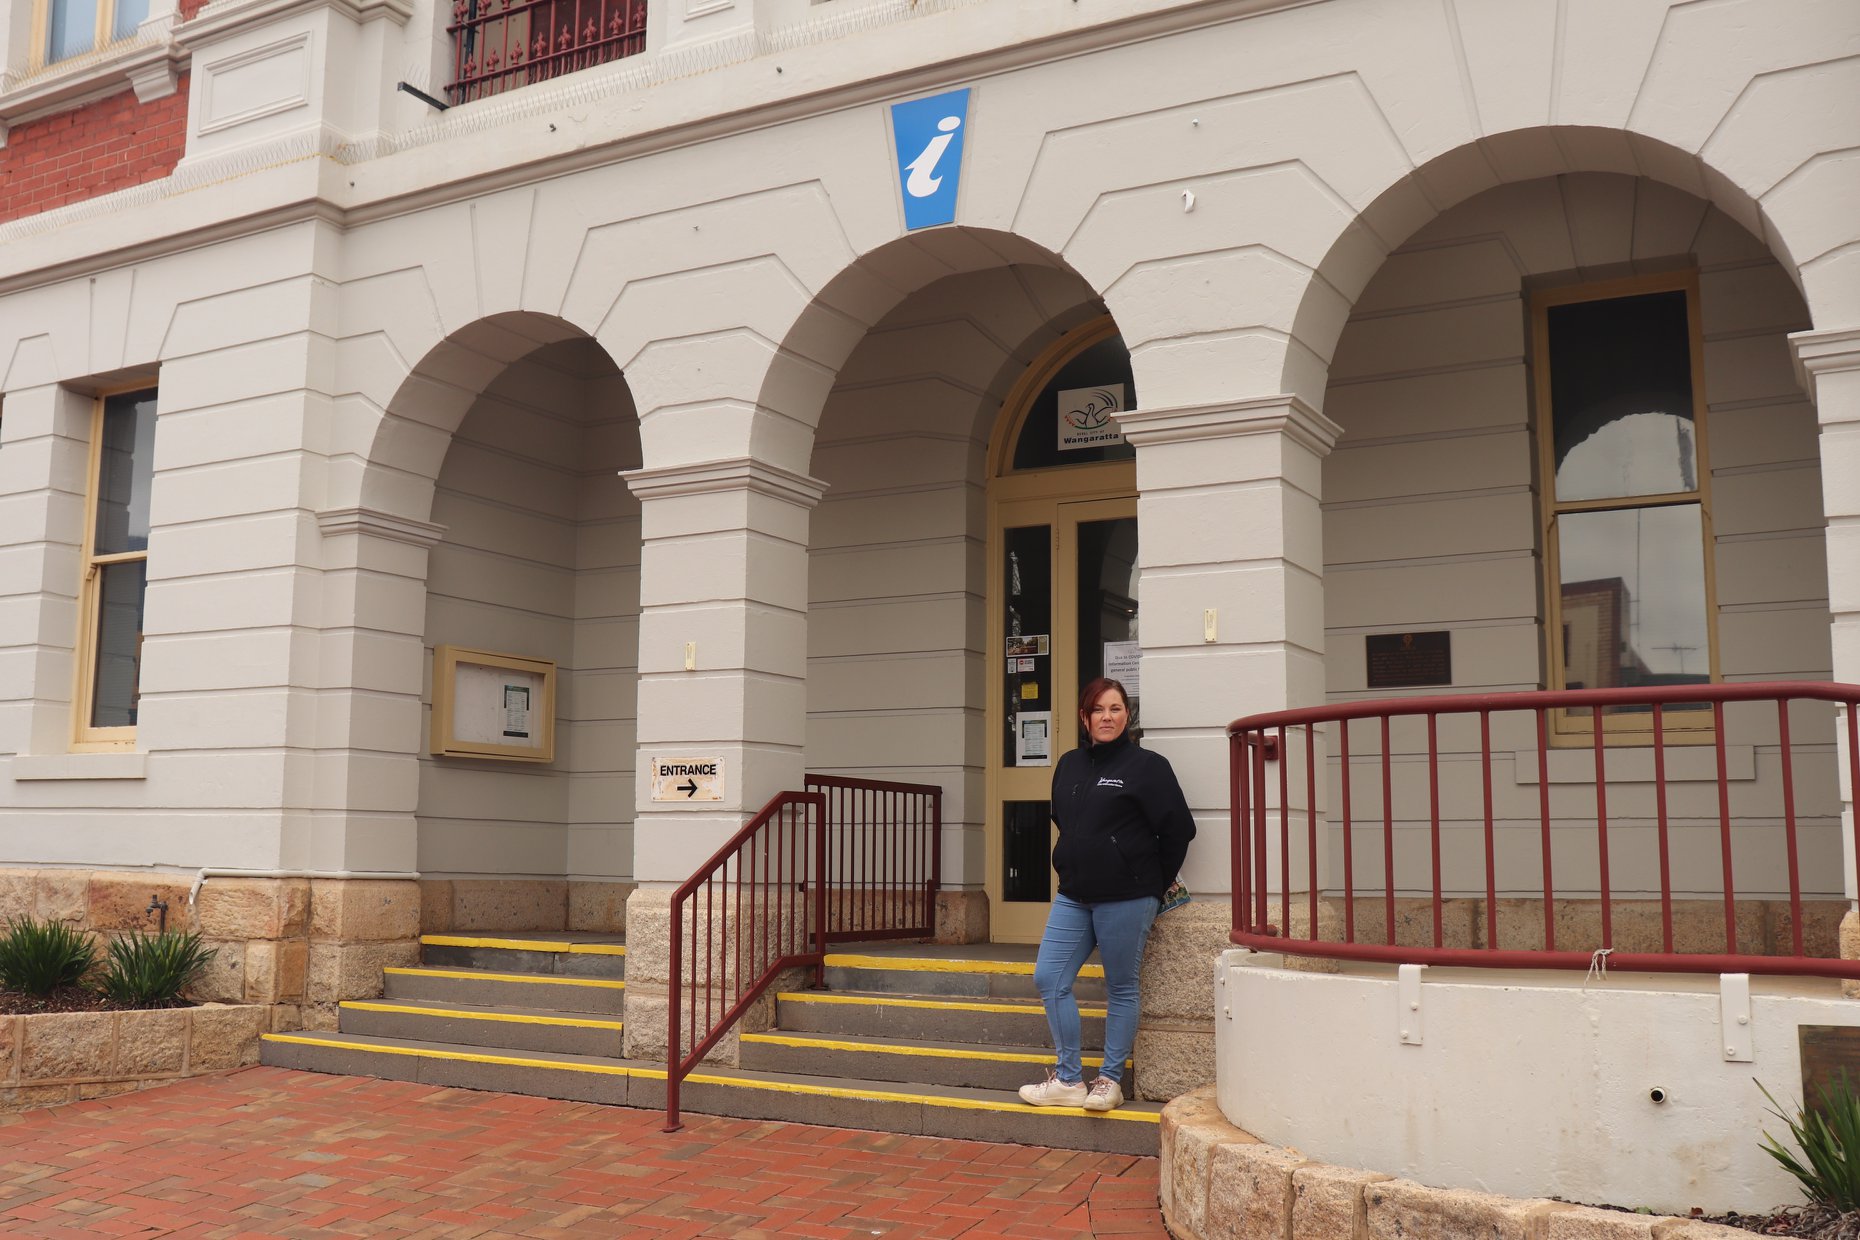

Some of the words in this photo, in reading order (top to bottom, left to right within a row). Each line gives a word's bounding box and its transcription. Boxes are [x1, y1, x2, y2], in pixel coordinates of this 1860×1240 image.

[904, 115, 961, 198] i
[1064, 433, 1119, 443] Wangaratta
[660, 764, 717, 776] ENTRANCE
